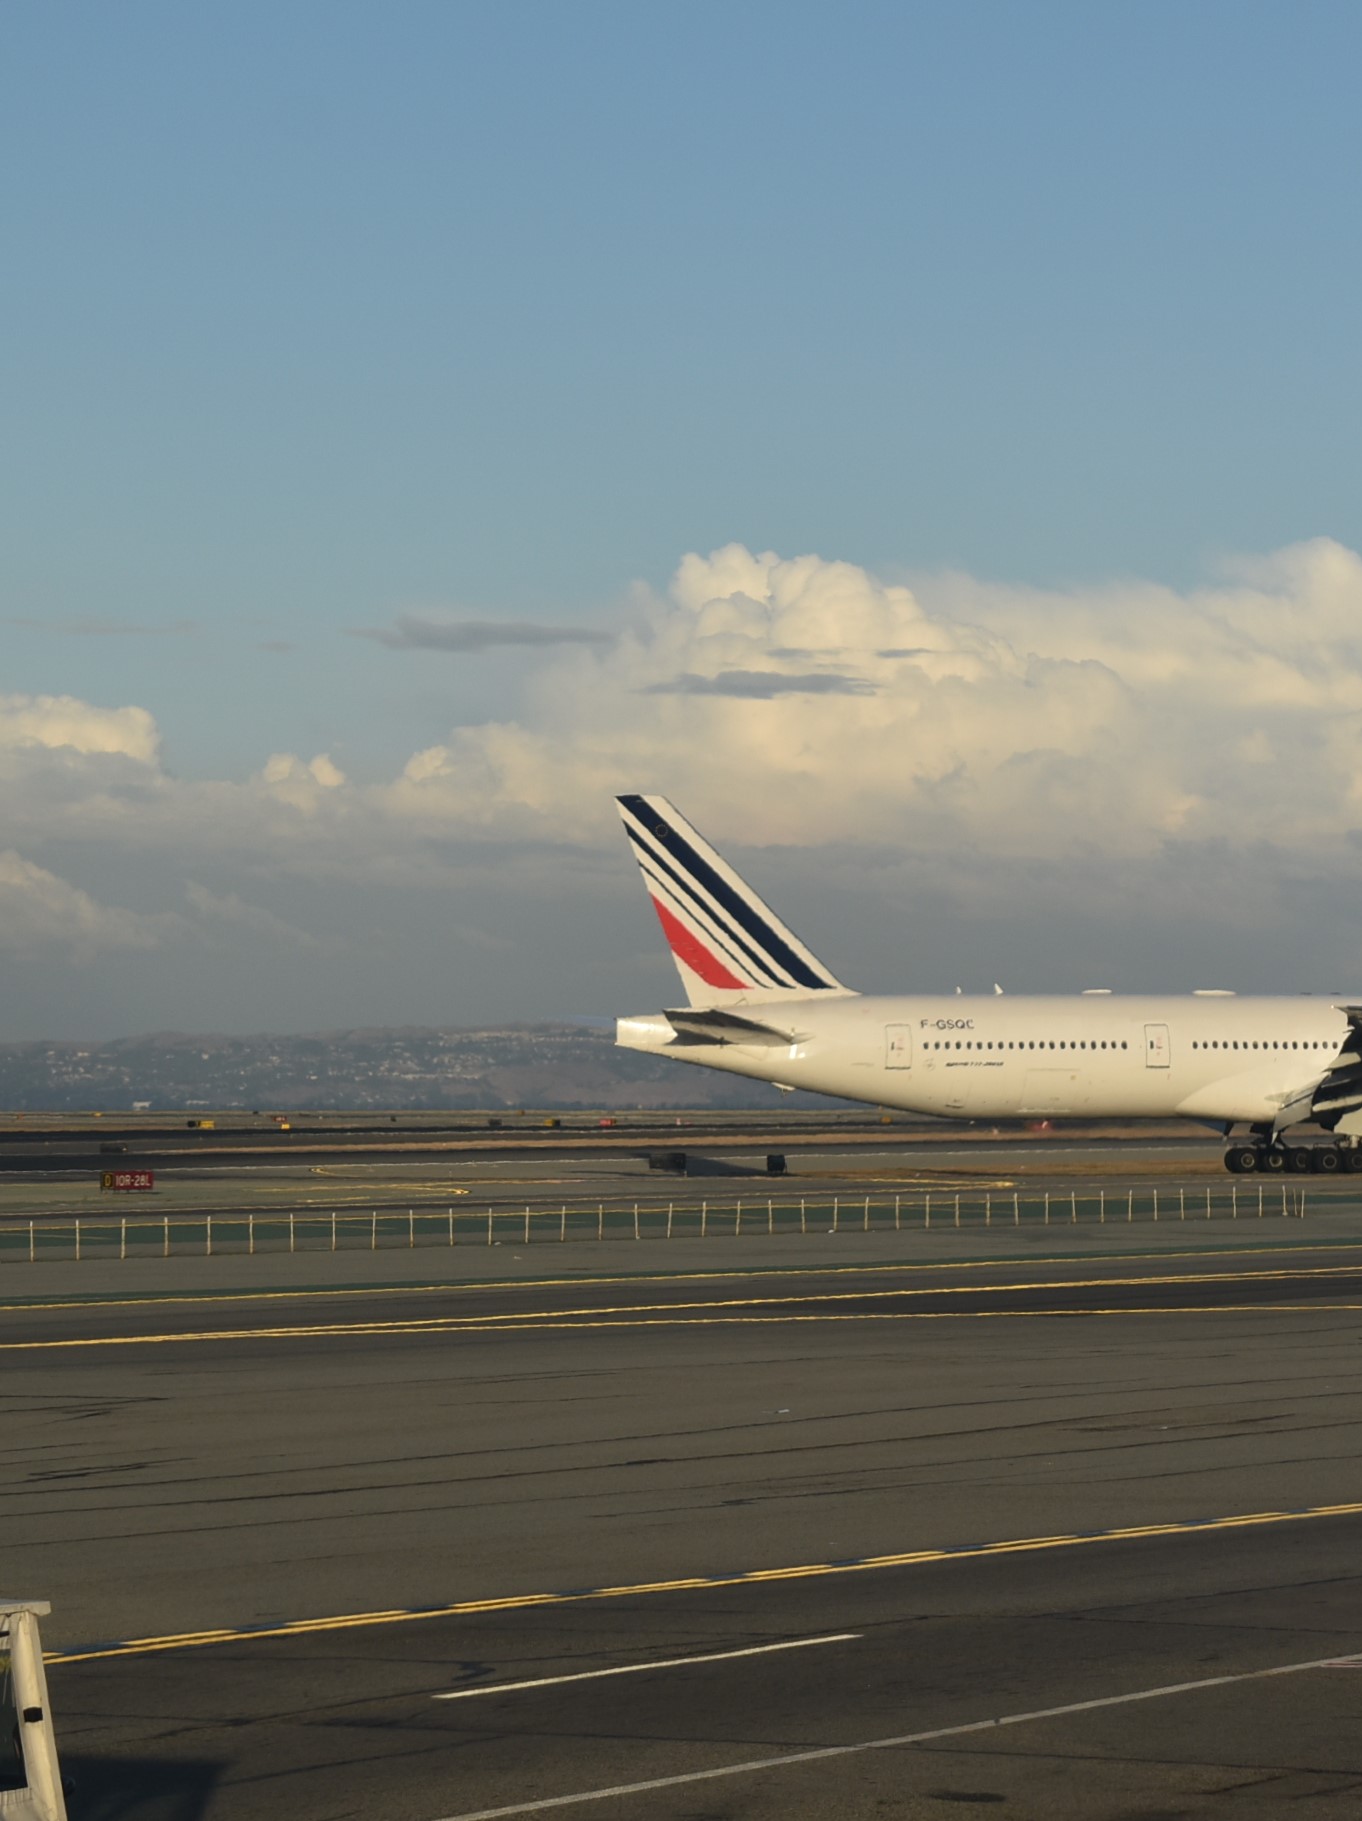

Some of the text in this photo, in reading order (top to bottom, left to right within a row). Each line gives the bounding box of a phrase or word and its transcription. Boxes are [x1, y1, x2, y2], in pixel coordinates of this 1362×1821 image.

[920, 1019, 975, 1030] F-GSQC
[104, 1174, 152, 1187] D 10R-28L
